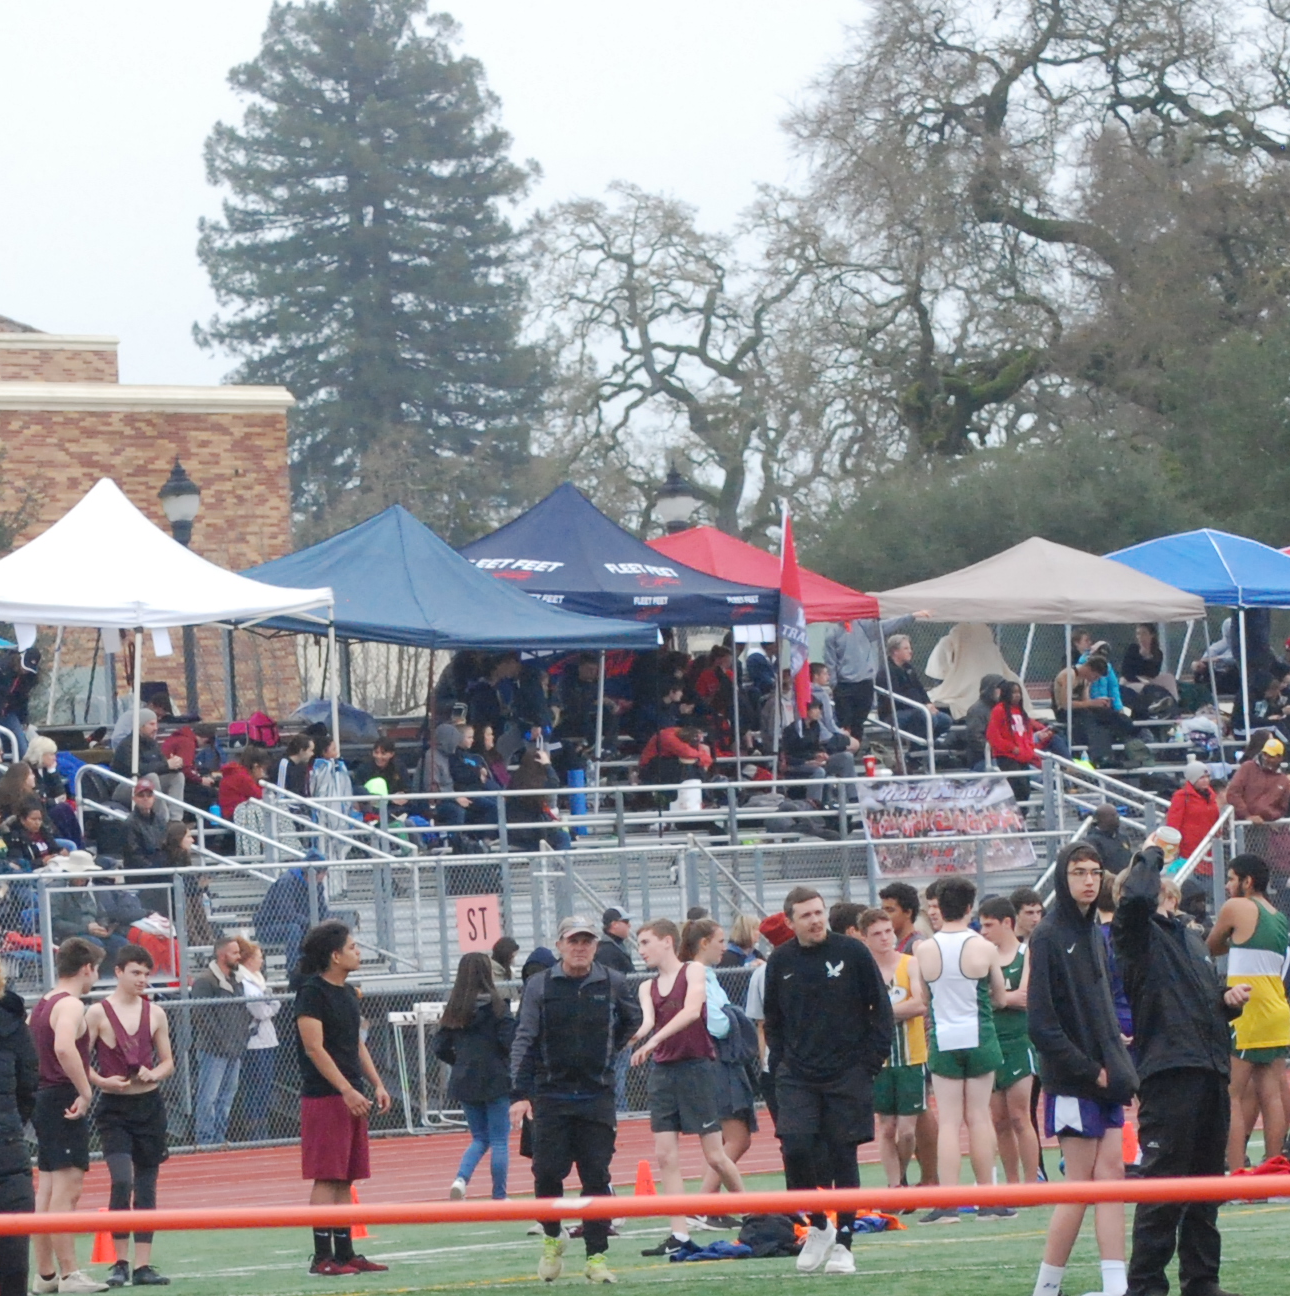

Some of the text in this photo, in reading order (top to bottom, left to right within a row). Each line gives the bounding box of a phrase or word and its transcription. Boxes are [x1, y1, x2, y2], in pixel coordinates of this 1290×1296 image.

[511, 559, 565, 573] FEET
[604, 562, 679, 578] FLEET FEET
[467, 907, 487, 941] ST
